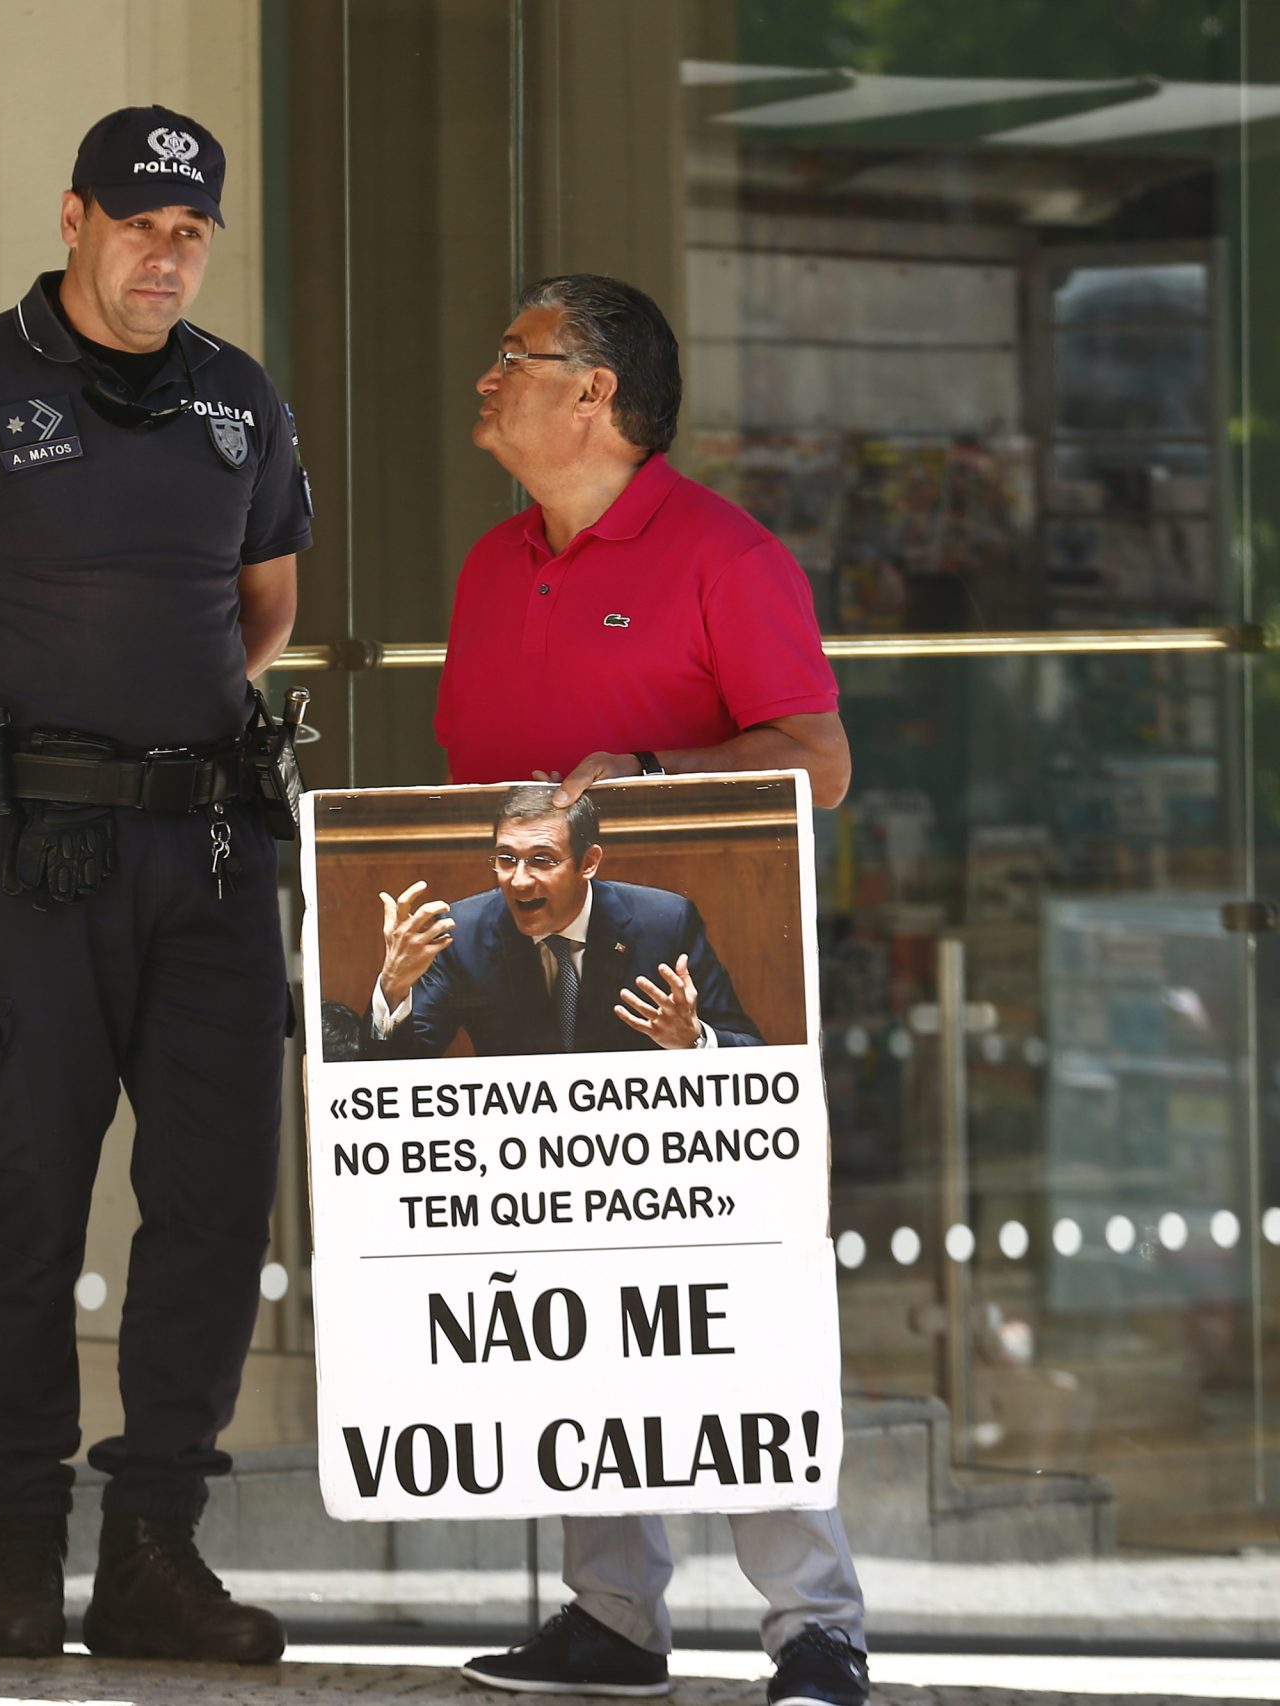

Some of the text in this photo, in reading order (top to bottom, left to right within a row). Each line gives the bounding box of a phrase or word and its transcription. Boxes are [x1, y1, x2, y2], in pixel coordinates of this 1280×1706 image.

[12, 443, 72, 465] A. MATOS
[330, 1071, 800, 1121] «SE ESTAVA GARANTIDO
[334, 1126, 800, 1178] NO BES, O NOVO BANCO
[399, 1186, 735, 1229] TEM QUE PAGAR»
[428, 1270, 736, 1365] NÃO ME
[341, 1410, 821, 1498] VOU CALAR!
